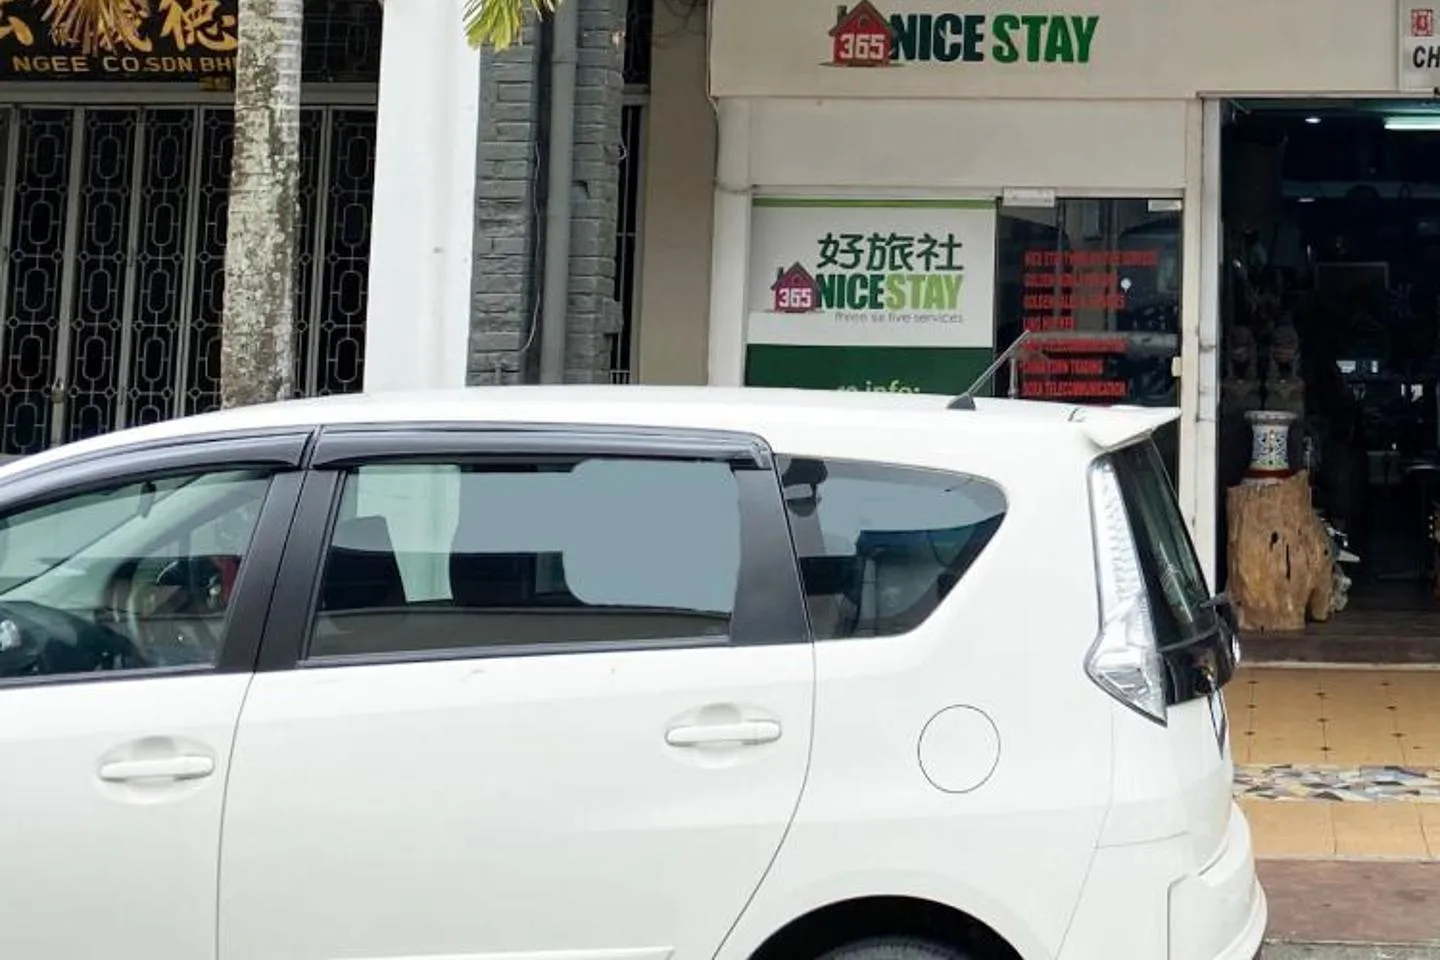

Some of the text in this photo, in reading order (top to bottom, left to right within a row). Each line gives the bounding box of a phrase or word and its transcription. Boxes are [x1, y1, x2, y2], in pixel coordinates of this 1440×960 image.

[840, 13, 1099, 63] 365 NICE STAY
[12, 55, 90, 72] NGEE
[816, 233, 964, 271] 好旅社
[779, 274, 964, 311] 365 NICE STAY
